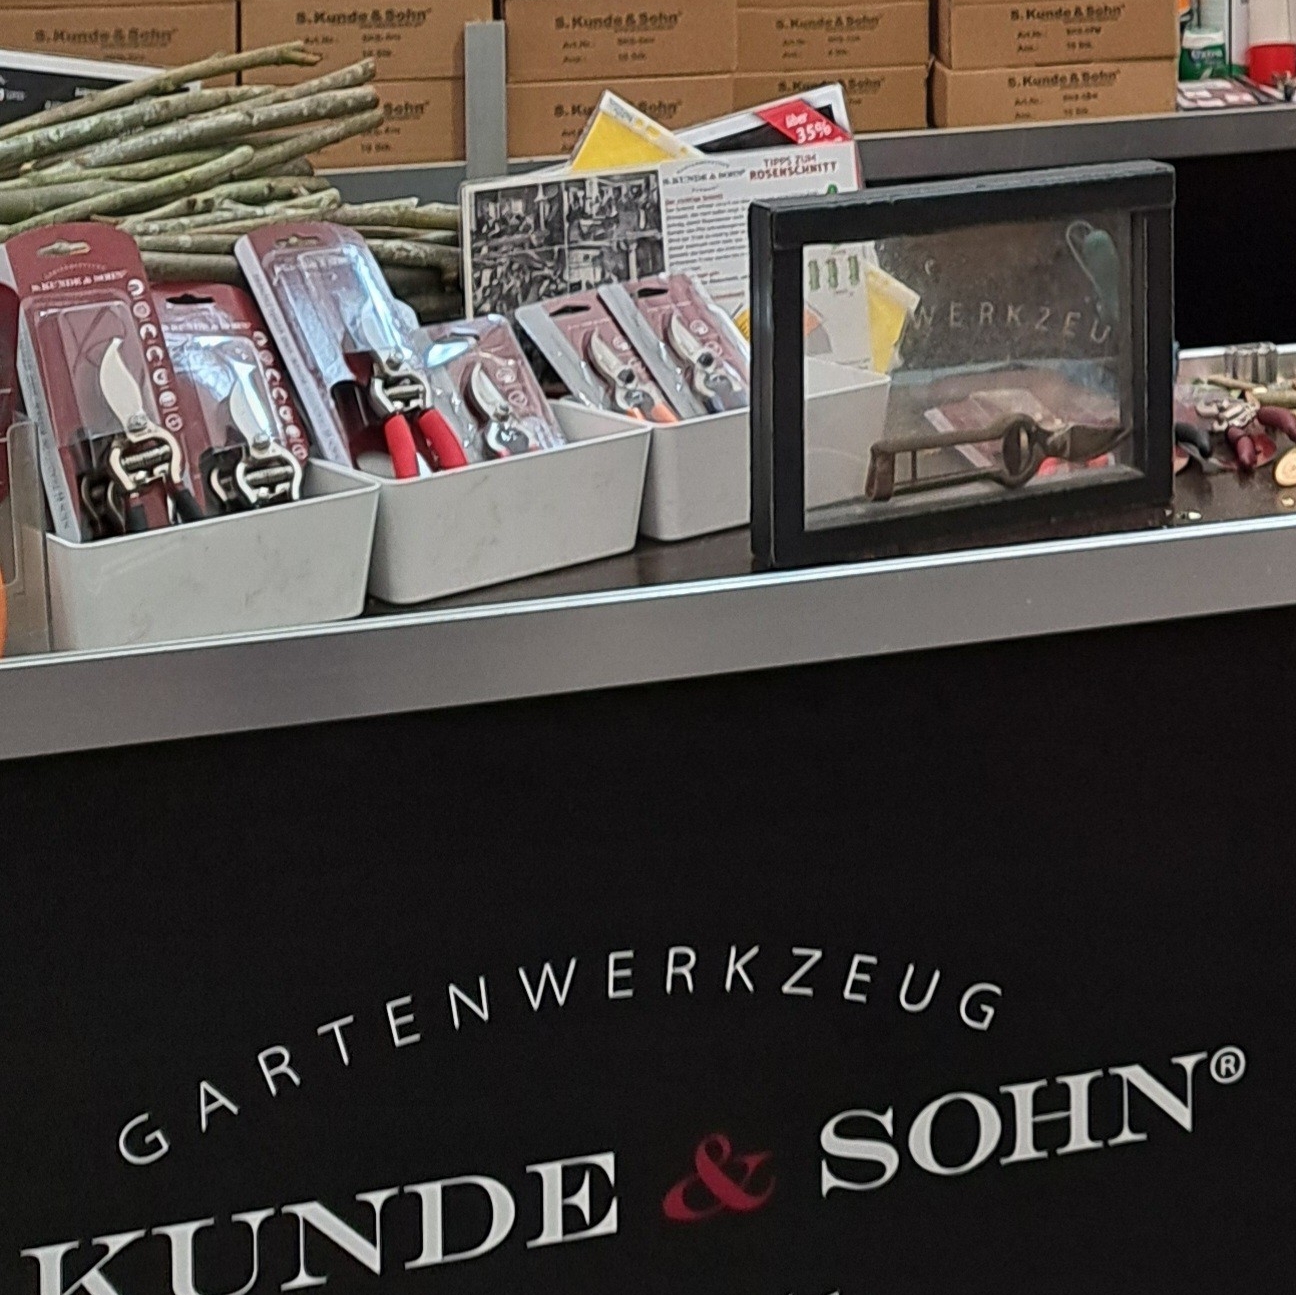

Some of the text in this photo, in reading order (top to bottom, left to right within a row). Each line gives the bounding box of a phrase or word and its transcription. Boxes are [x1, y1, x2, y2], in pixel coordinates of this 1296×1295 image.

[796, 122, 832, 144] 35%
[750, 161, 837, 181] ROSENSCHNITT
[118, 945, 1002, 1166] GARTENWERKZEUG
[661, 1133, 777, 1222] &
